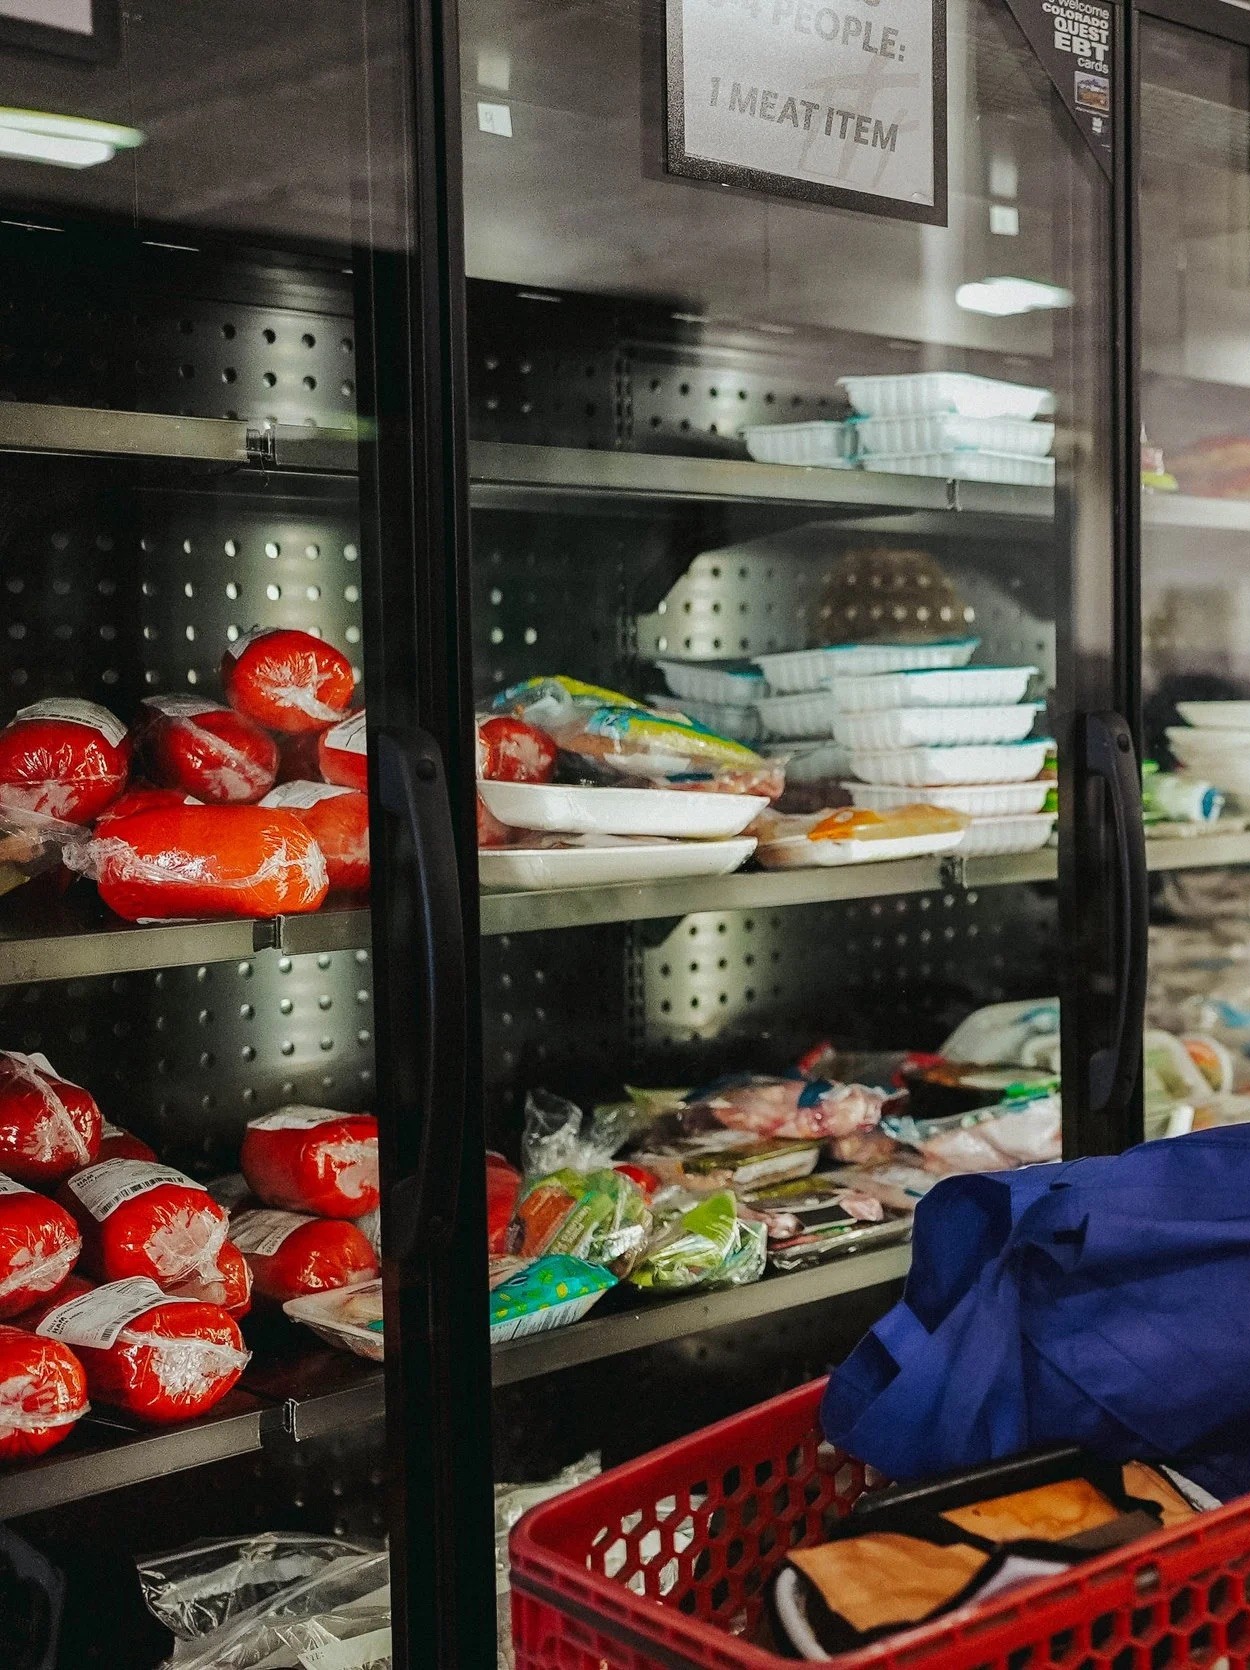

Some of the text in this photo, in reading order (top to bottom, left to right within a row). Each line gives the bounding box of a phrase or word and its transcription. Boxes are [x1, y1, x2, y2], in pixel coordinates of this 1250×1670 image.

[1042, 3, 1109, 30] COLORADO
[1054, 16, 1109, 44] QUEST
[772, 0, 906, 62] PEOPLE:
[1054, 30, 1109, 62] EBT
[1077, 57, 1109, 74] cards
[709, 76, 899, 153] 1 MEAT ITEM
[51, 1316, 67, 1334] HAM
